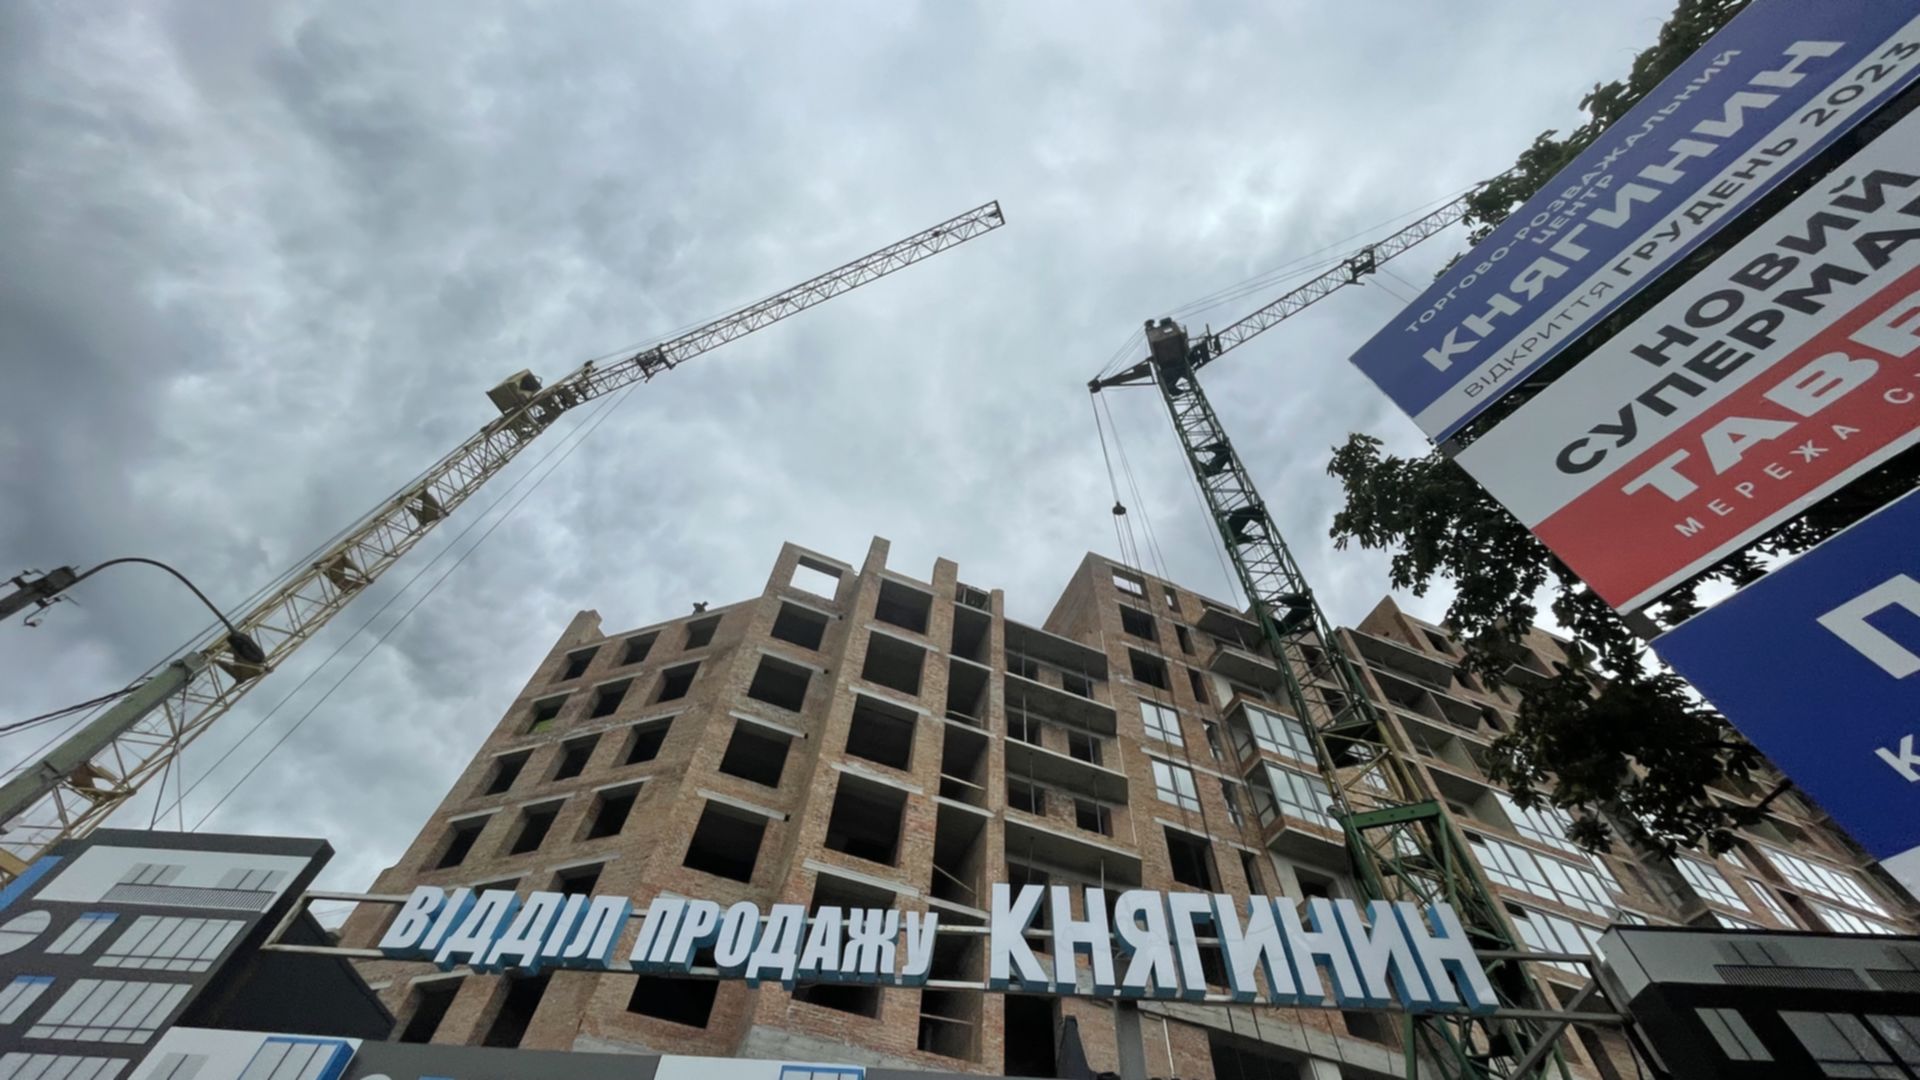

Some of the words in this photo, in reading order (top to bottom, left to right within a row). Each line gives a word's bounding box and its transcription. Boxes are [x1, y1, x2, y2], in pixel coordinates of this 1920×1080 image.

[1405, 50, 1742, 332] ТОРГОВО-РОЗВАЖАЛЬНИЙ
[1422, 40, 1846, 373] КНЯГИНИН
[1463, 280, 1615, 398] ВІДКРИТТЯ
[1612, 136, 1798, 277] ГРУДЕНЬ
[1800, 42, 1920, 127] 2023
[1532, 173, 1615, 245] ЦЕНТР
[1630, 169, 1920, 367] НОВИЙ
[1674, 423, 1860, 537] МЕРЕЖА
[378, 884, 634, 975] ВІДДІЛ
[629, 899, 939, 990] ПРОДАЖУ
[990, 882, 1499, 1014] КНЯГИНИН
